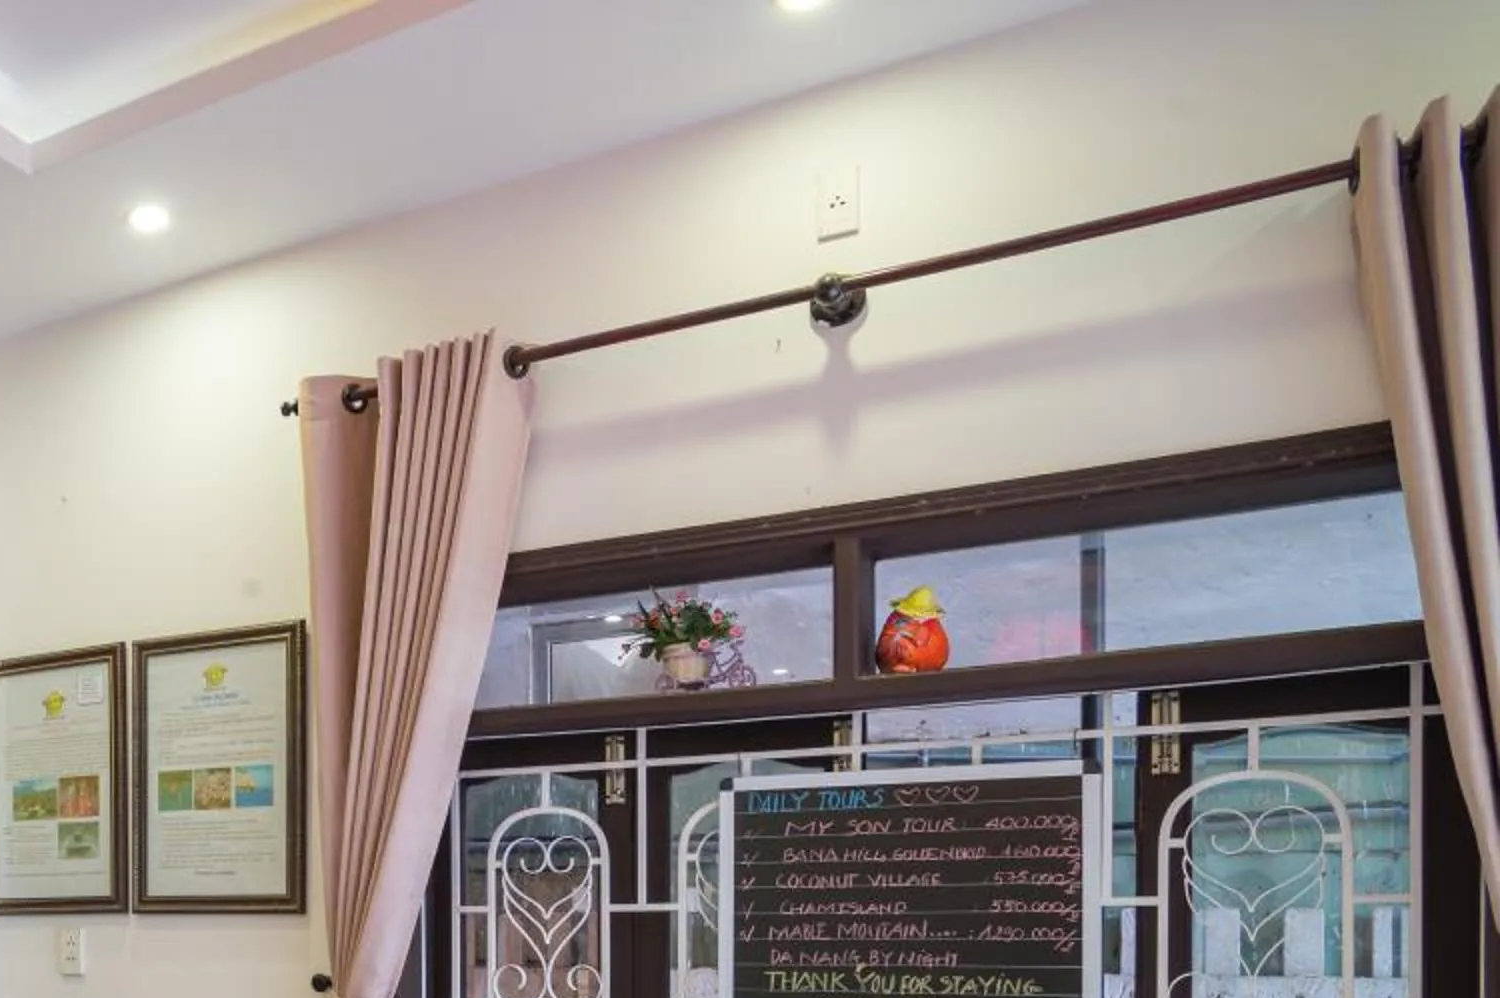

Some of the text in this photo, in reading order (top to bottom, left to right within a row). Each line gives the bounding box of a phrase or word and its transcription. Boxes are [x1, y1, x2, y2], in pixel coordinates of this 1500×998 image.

[748, 788, 885, 813] DAILY TOURS
[784, 820, 835, 837] MY
[848, 818, 891, 835] SON
[775, 873, 860, 889] COCONUT
[868, 871, 941, 888] VILLAGE
[868, 949, 893, 967] BY
[763, 970, 850, 993] THANK
[854, 961, 895, 995] YOU
[901, 974, 937, 995] FOR
